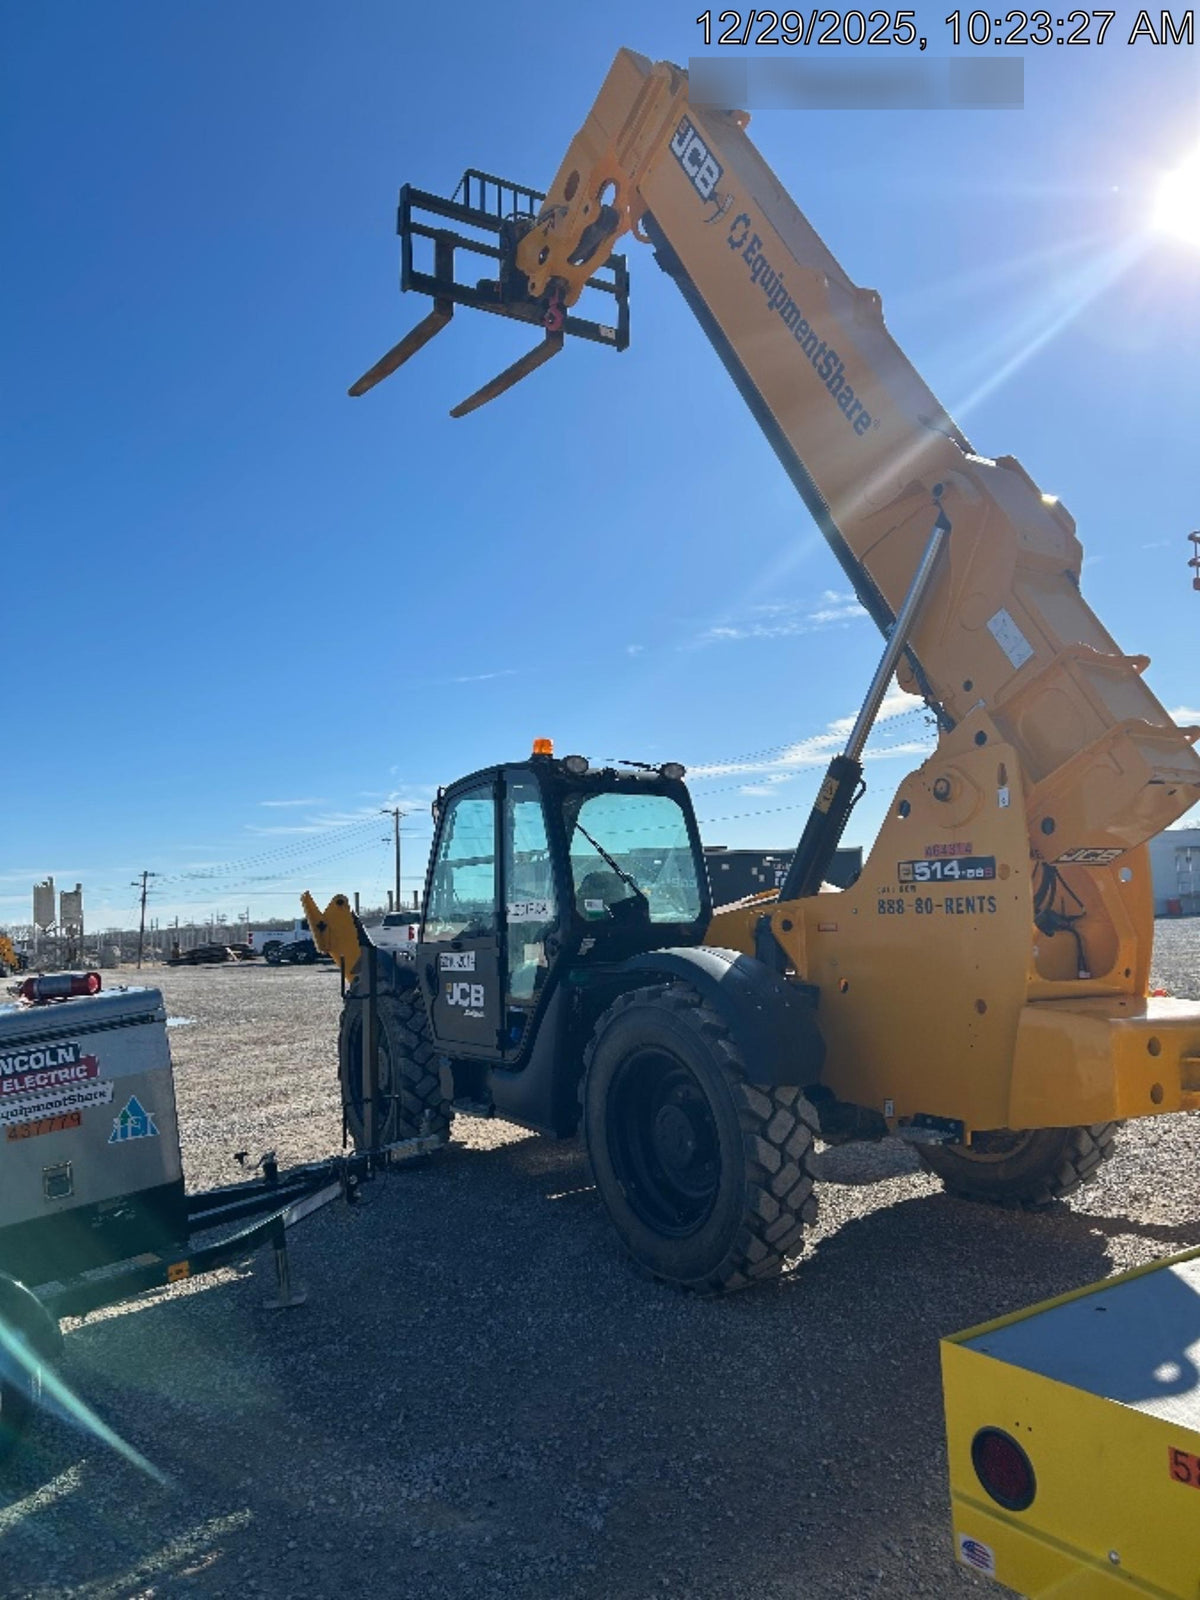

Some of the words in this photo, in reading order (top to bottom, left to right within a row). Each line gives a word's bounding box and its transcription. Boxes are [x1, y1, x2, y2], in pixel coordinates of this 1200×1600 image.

[671, 124, 722, 199] JCB
[741, 234, 872, 436] EquipmentShare
[878, 896, 997, 914] 888-80-RENTS
[446, 983, 484, 1007] JCB
[3, 1065, 88, 1092] ELECTRIC
